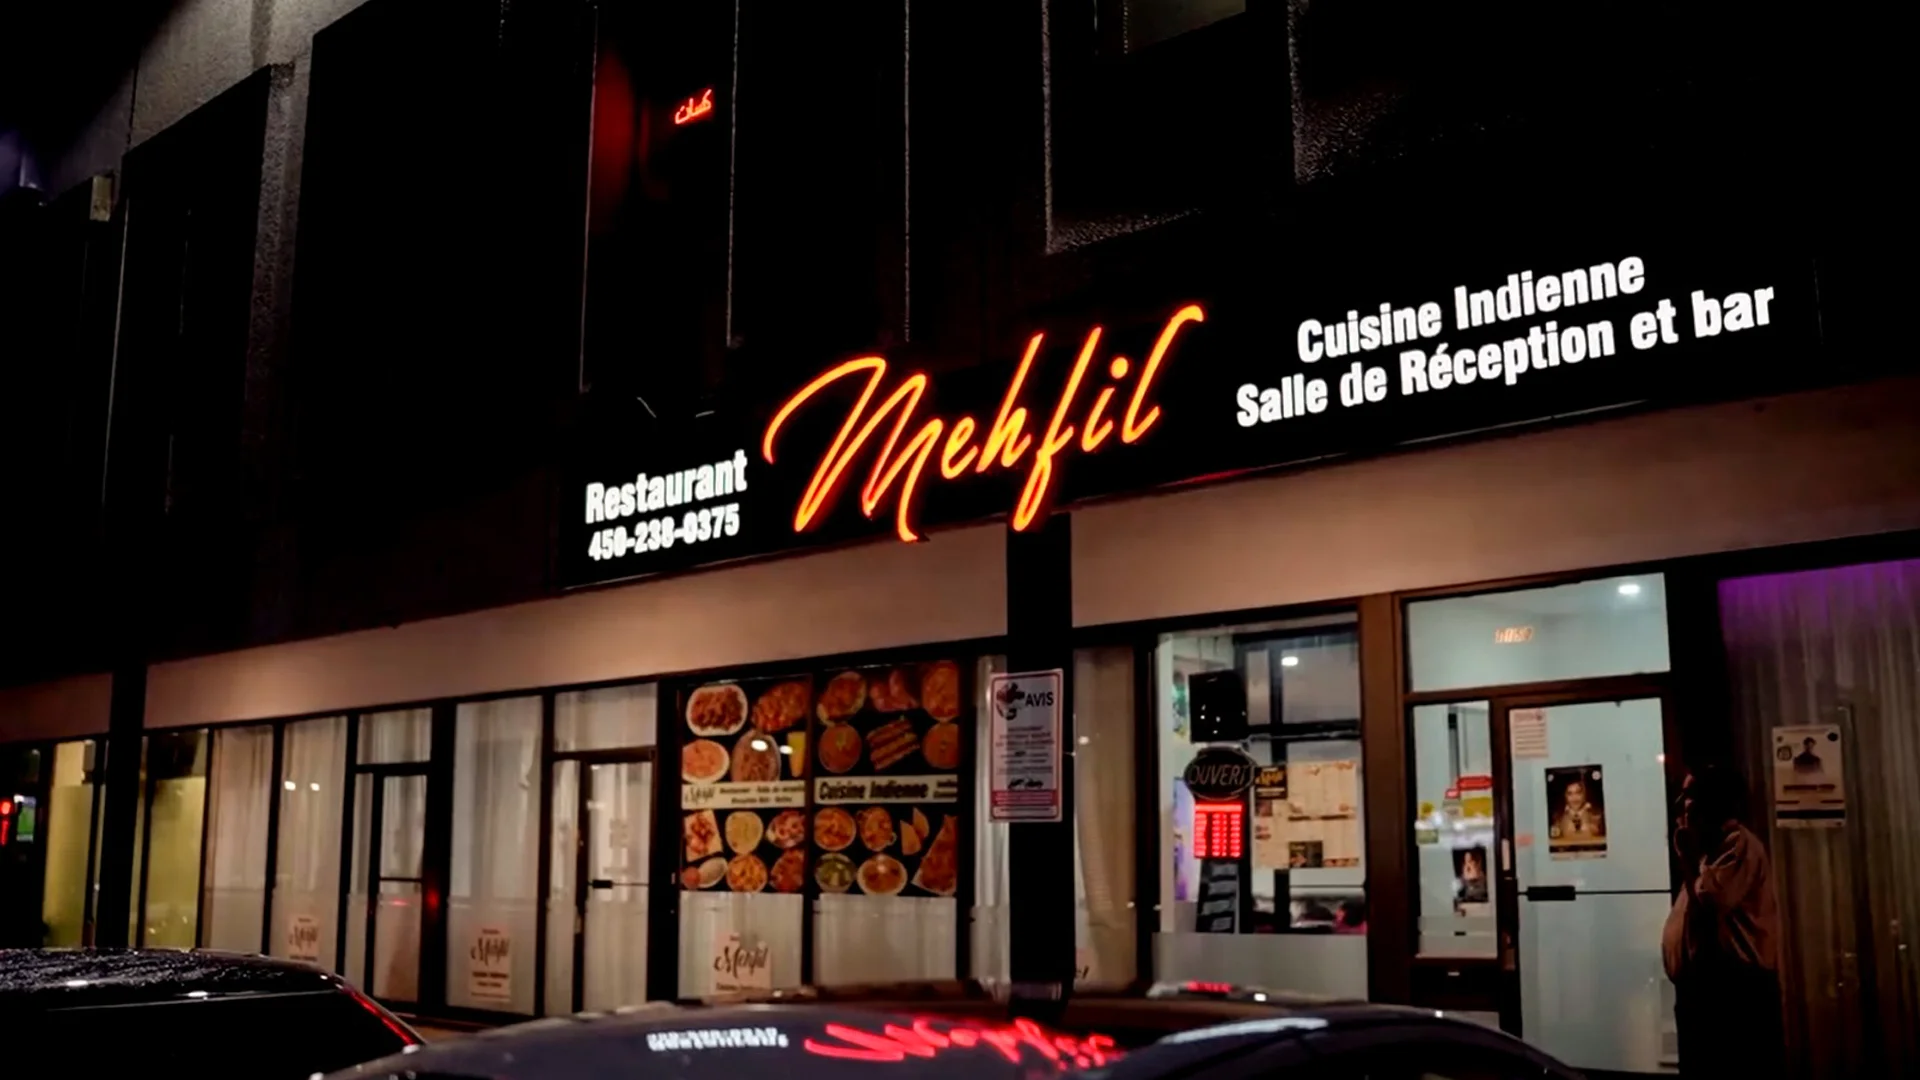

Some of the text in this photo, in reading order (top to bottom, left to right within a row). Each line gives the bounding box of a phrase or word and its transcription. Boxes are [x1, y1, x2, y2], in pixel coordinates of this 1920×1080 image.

[1297, 256, 1645, 363] Cuisine Indienne
[1236, 286, 1775, 428] Salle de Réception et bar
[763, 303, 1205, 543] Mehfil
[585, 449, 748, 524] Restaurant
[587, 502, 740, 561] 450-238-0375
[1025, 691, 1054, 708] AVIS
[819, 780, 866, 800] Cuisine
[869, 779, 929, 798] Indienne
[1188, 763, 1250, 786] OUVERT
